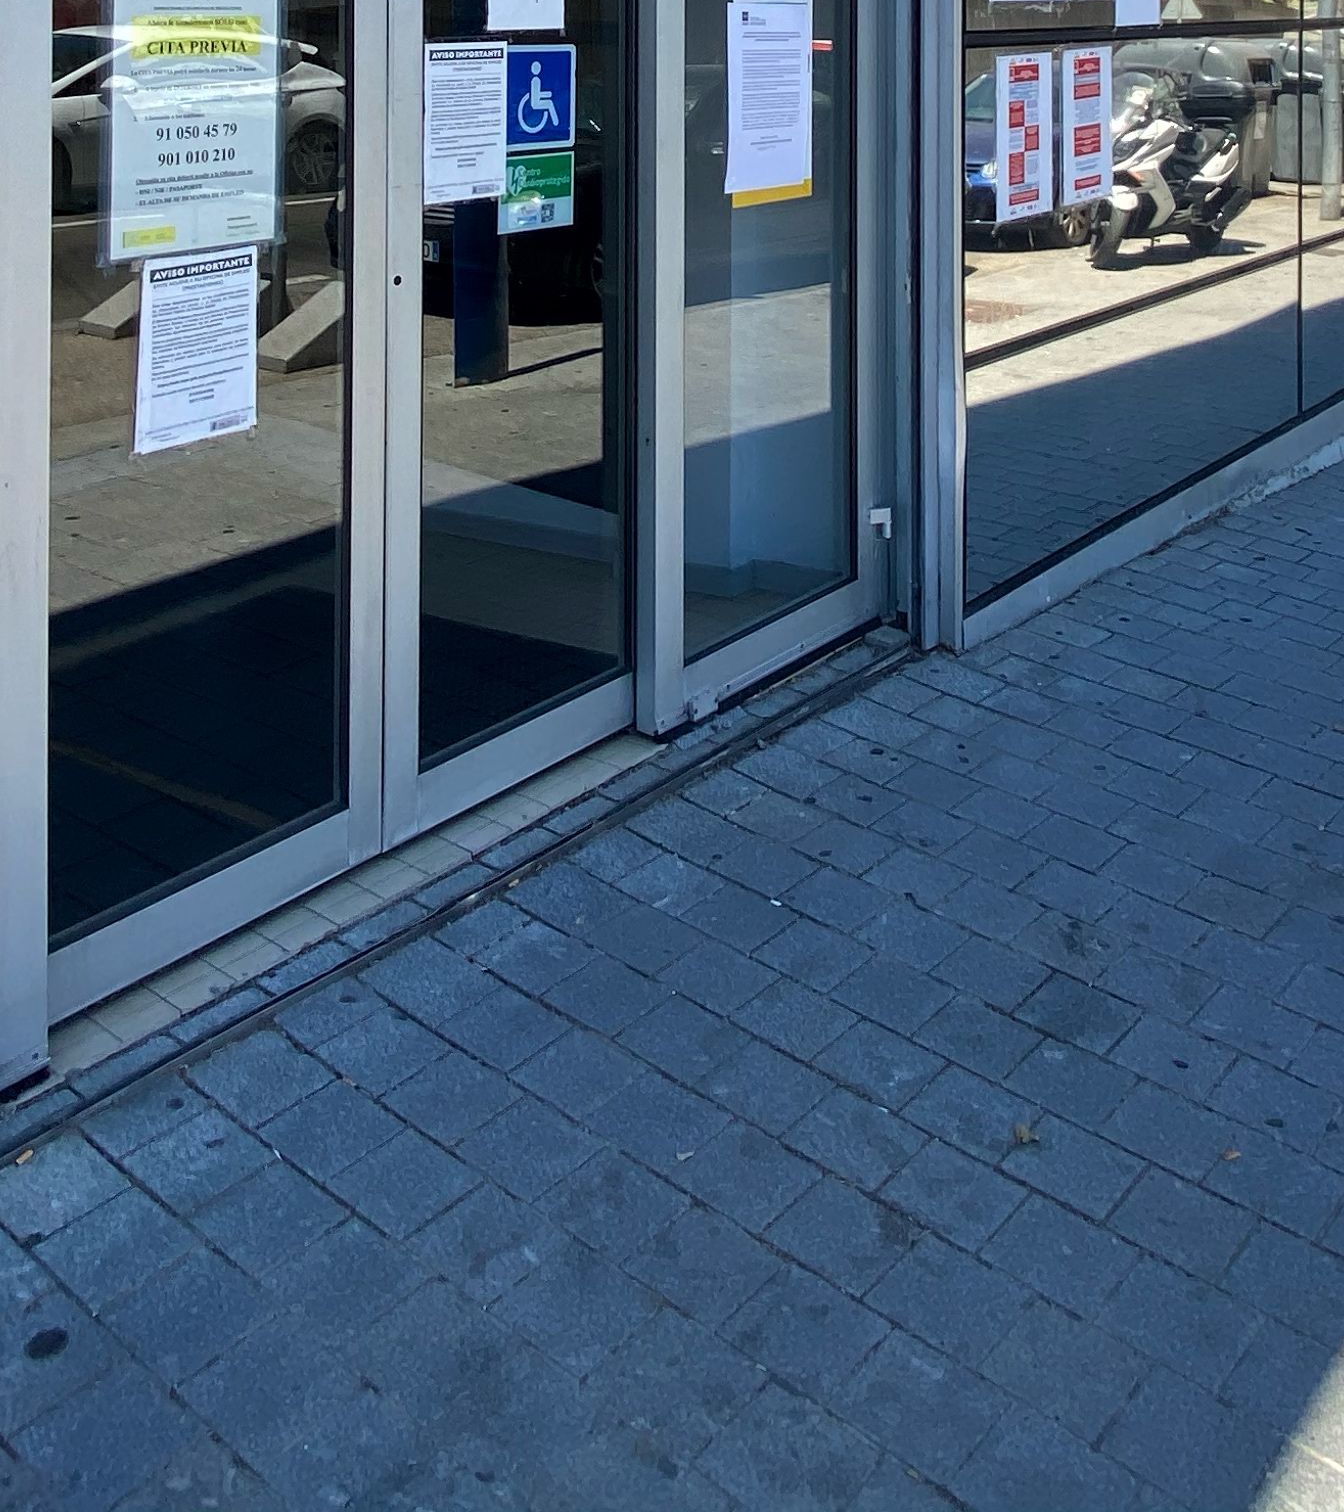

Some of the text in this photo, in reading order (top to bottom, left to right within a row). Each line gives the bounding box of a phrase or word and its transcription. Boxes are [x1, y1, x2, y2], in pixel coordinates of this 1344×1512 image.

[147, 40, 247, 55] CITA PREVIA
[432, 50, 501, 59] AVISO IMPORTANTE
[156, 123, 238, 141] 91 050 45 79
[158, 148, 235, 167] 901 010 210
[153, 257, 250, 280] AVISO IMPORTANTE
